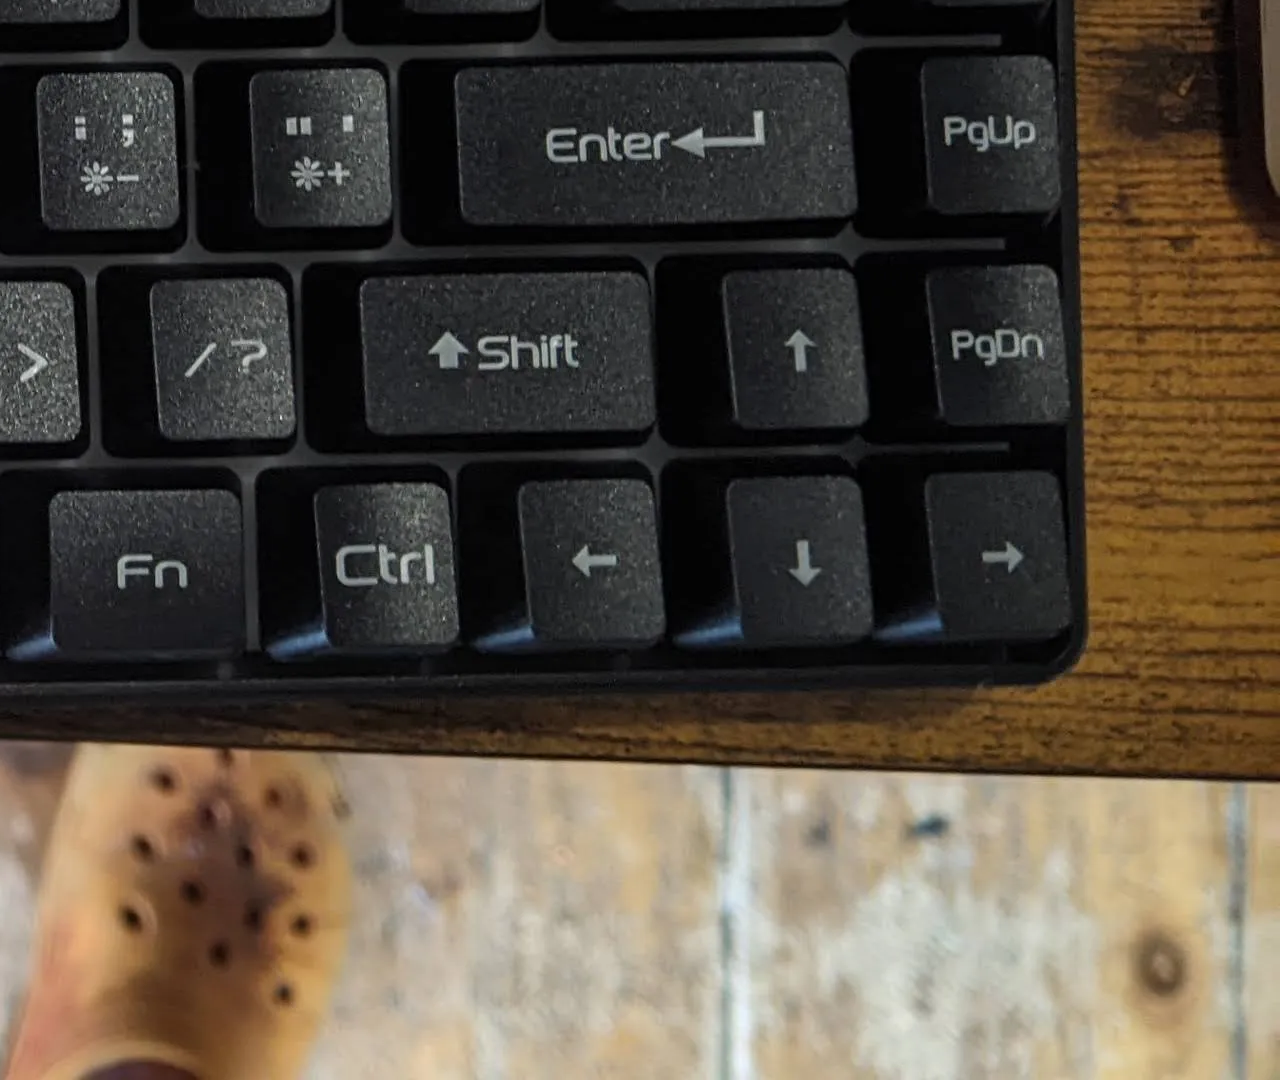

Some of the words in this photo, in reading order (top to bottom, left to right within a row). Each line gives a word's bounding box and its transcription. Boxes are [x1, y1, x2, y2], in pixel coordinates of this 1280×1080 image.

[545, 126, 671, 163] Enter
[944, 115, 1037, 152] PgUp
[477, 333, 580, 370] Shift
[951, 329, 1045, 366] PgDn
[116, 554, 188, 589] Fn
[336, 543, 435, 585] Ctrl
